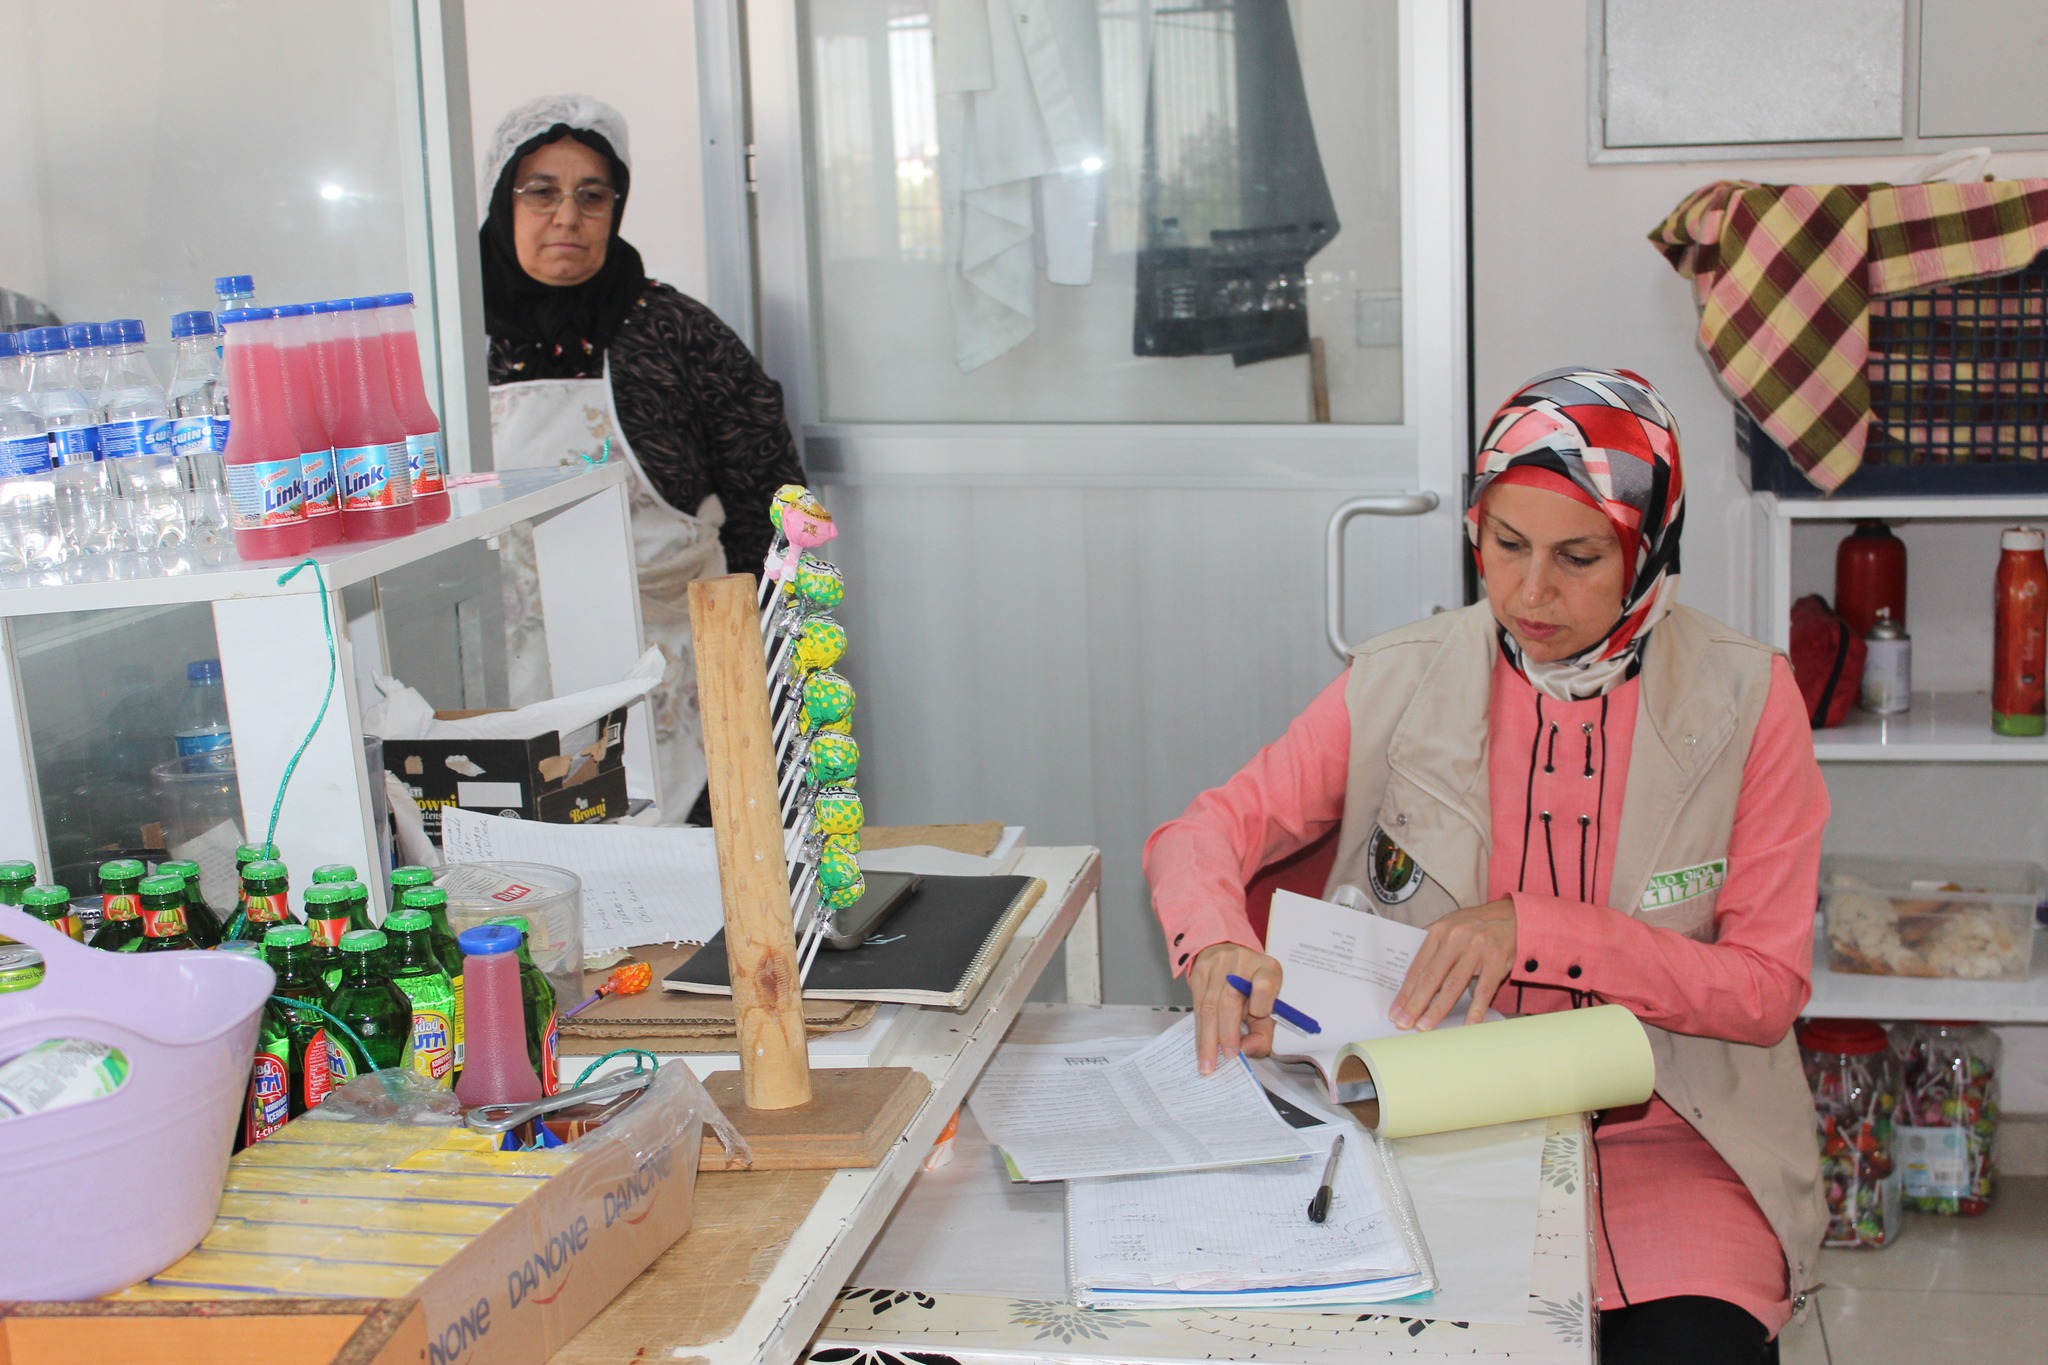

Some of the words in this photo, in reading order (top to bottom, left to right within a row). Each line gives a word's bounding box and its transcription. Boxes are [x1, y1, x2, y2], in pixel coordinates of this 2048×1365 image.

[264, 479, 302, 512] Link
[304, 469, 335, 501] Link
[345, 465, 386, 497] Link
[569, 797, 606, 823] Browni
[1647, 875, 1676, 891] ALO
[1682, 865, 1715, 882] GIDA
[508, 1215, 588, 1310] DANONE
[428, 1297, 491, 1365] NONE
